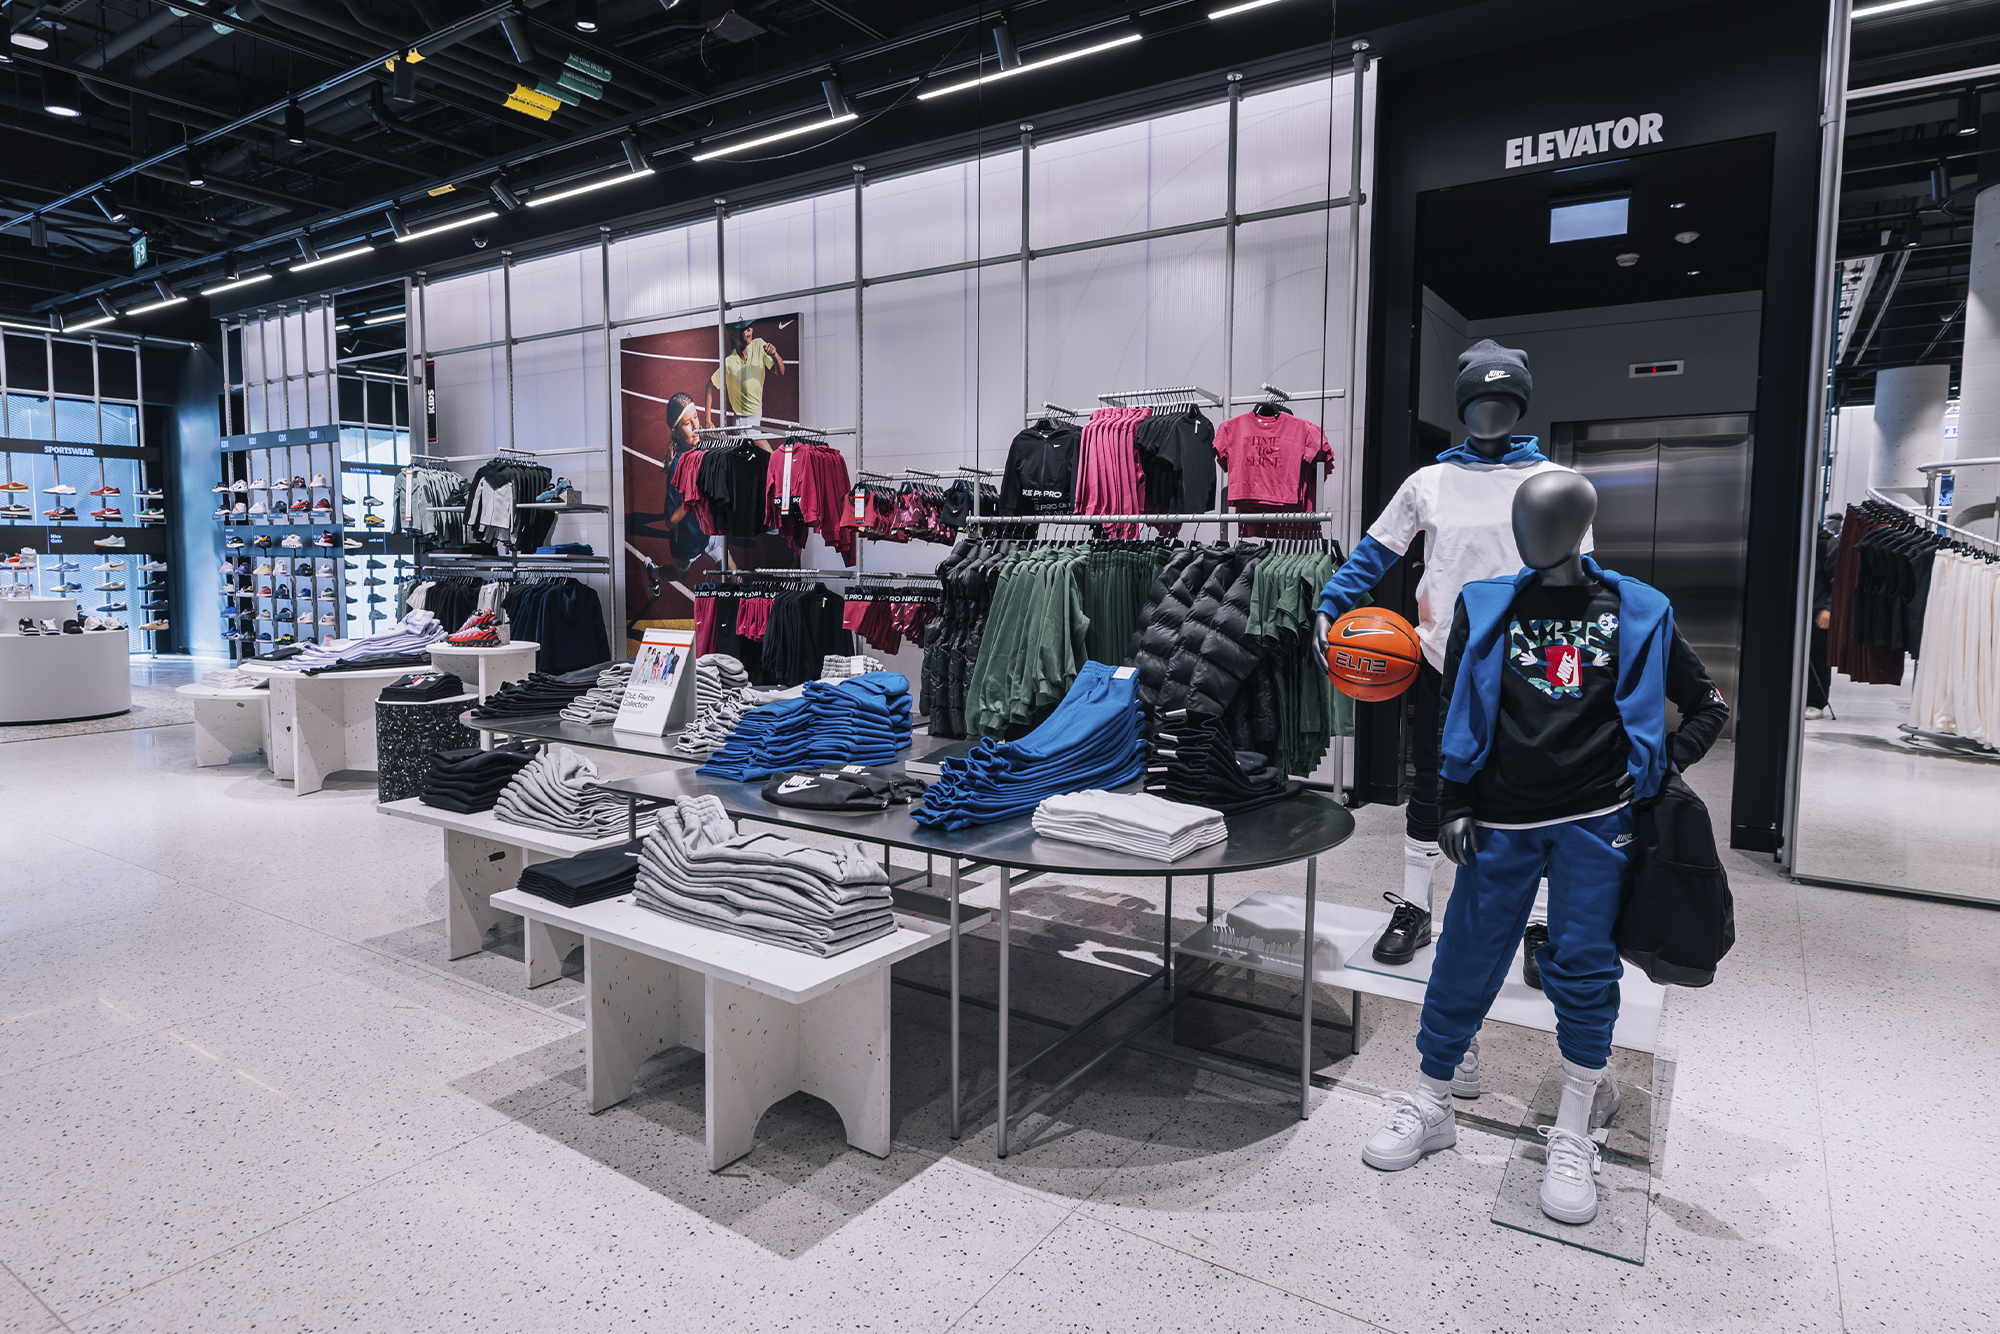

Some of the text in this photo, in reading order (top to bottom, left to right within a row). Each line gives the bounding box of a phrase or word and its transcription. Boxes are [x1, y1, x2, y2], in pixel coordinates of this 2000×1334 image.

[1505, 112, 1664, 169] ELEVATOR
[1250, 435, 1281, 447] TIME
[44, 445, 94, 456] SPORTSWEAR
[1256, 446, 1274, 456] TO
[1246, 456, 1281, 468] SHINE
[1043, 490, 1062, 498] PRO
[1335, 651, 1387, 673] ELITE
[1556, 651, 1575, 684] NIKE
[638, 692, 655, 701] Fleece
[622, 699, 648, 708] Collection
[785, 775, 815, 787] NIKE
